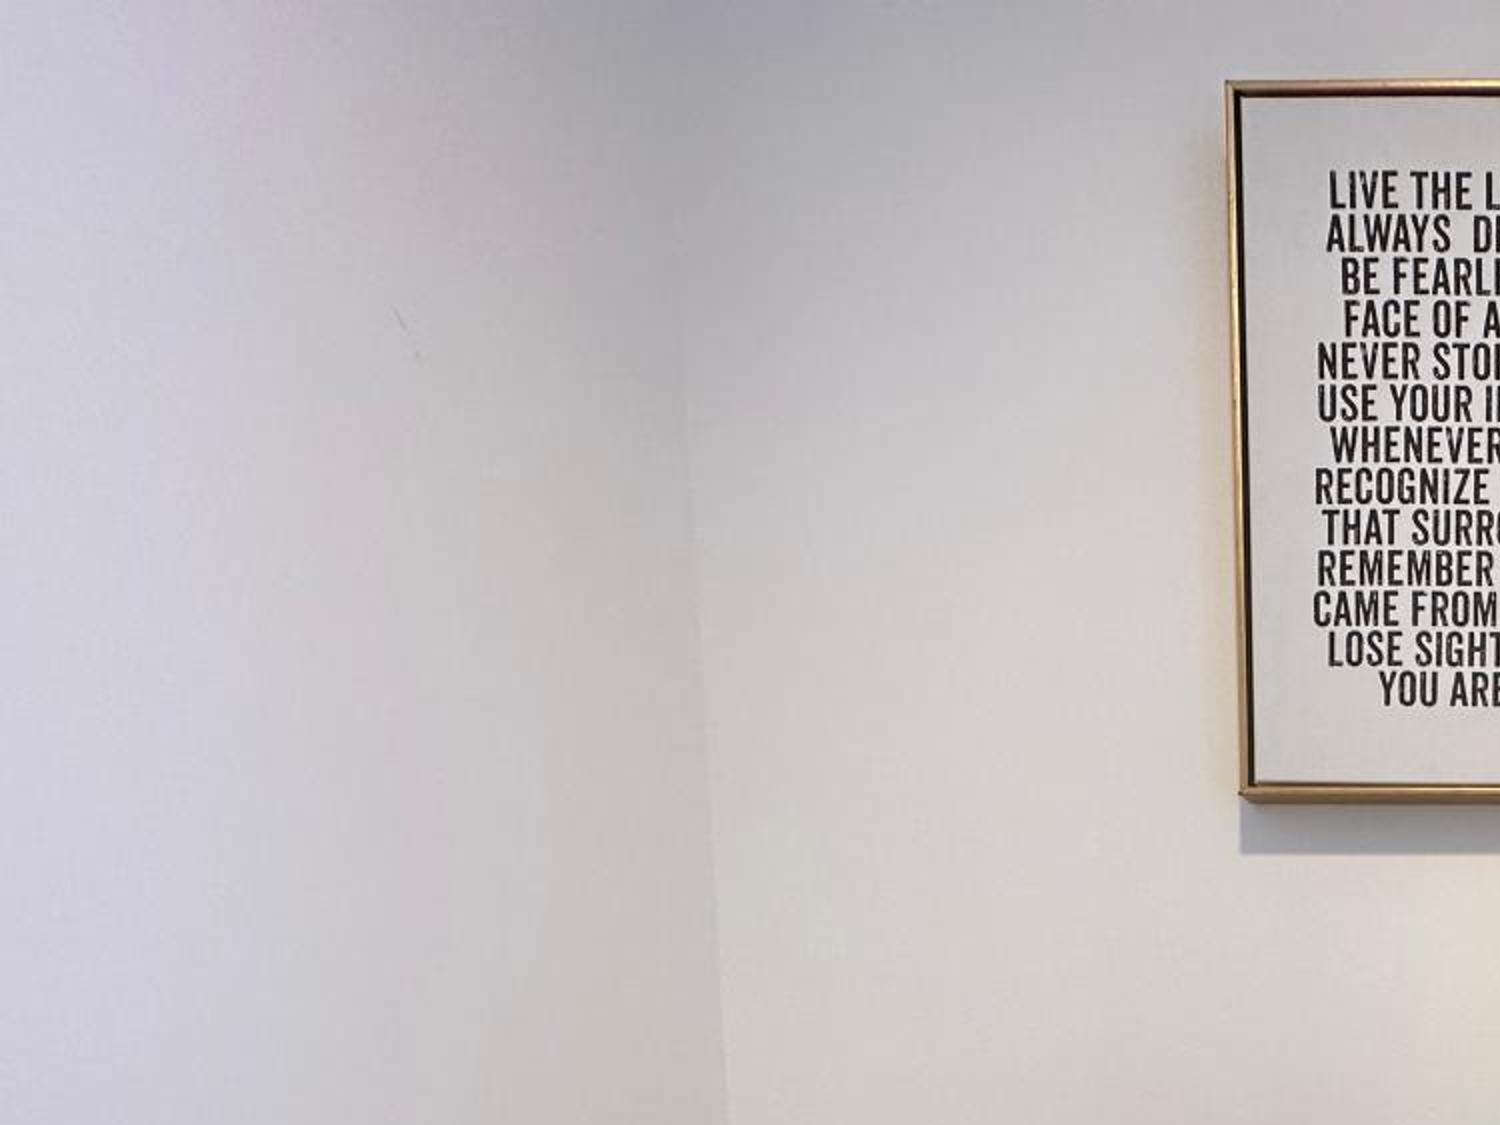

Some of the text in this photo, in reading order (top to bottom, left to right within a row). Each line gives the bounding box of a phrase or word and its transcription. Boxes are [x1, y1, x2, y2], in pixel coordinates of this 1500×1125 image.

[1329, 169, 1399, 210] LIVE
[1409, 169, 1473, 210] THE
[1325, 213, 1451, 253] ALWAYS
[1341, 256, 1381, 296] BE
[1344, 299, 1421, 338] FACE
[1432, 299, 1471, 338] OF
[1317, 341, 1421, 380] NEVER
[1317, 384, 1379, 422] USE
[1389, 384, 1473, 422] YOUR
[1315, 467, 1490, 505] RECOGNIZE
[1321, 508, 1401, 546] THAT
[1317, 549, 1494, 587] REMEMBER
[1313, 590, 1400, 628] CAME
[1328, 630, 1403, 667] LOSE
[1378, 671, 1439, 707] YOU
